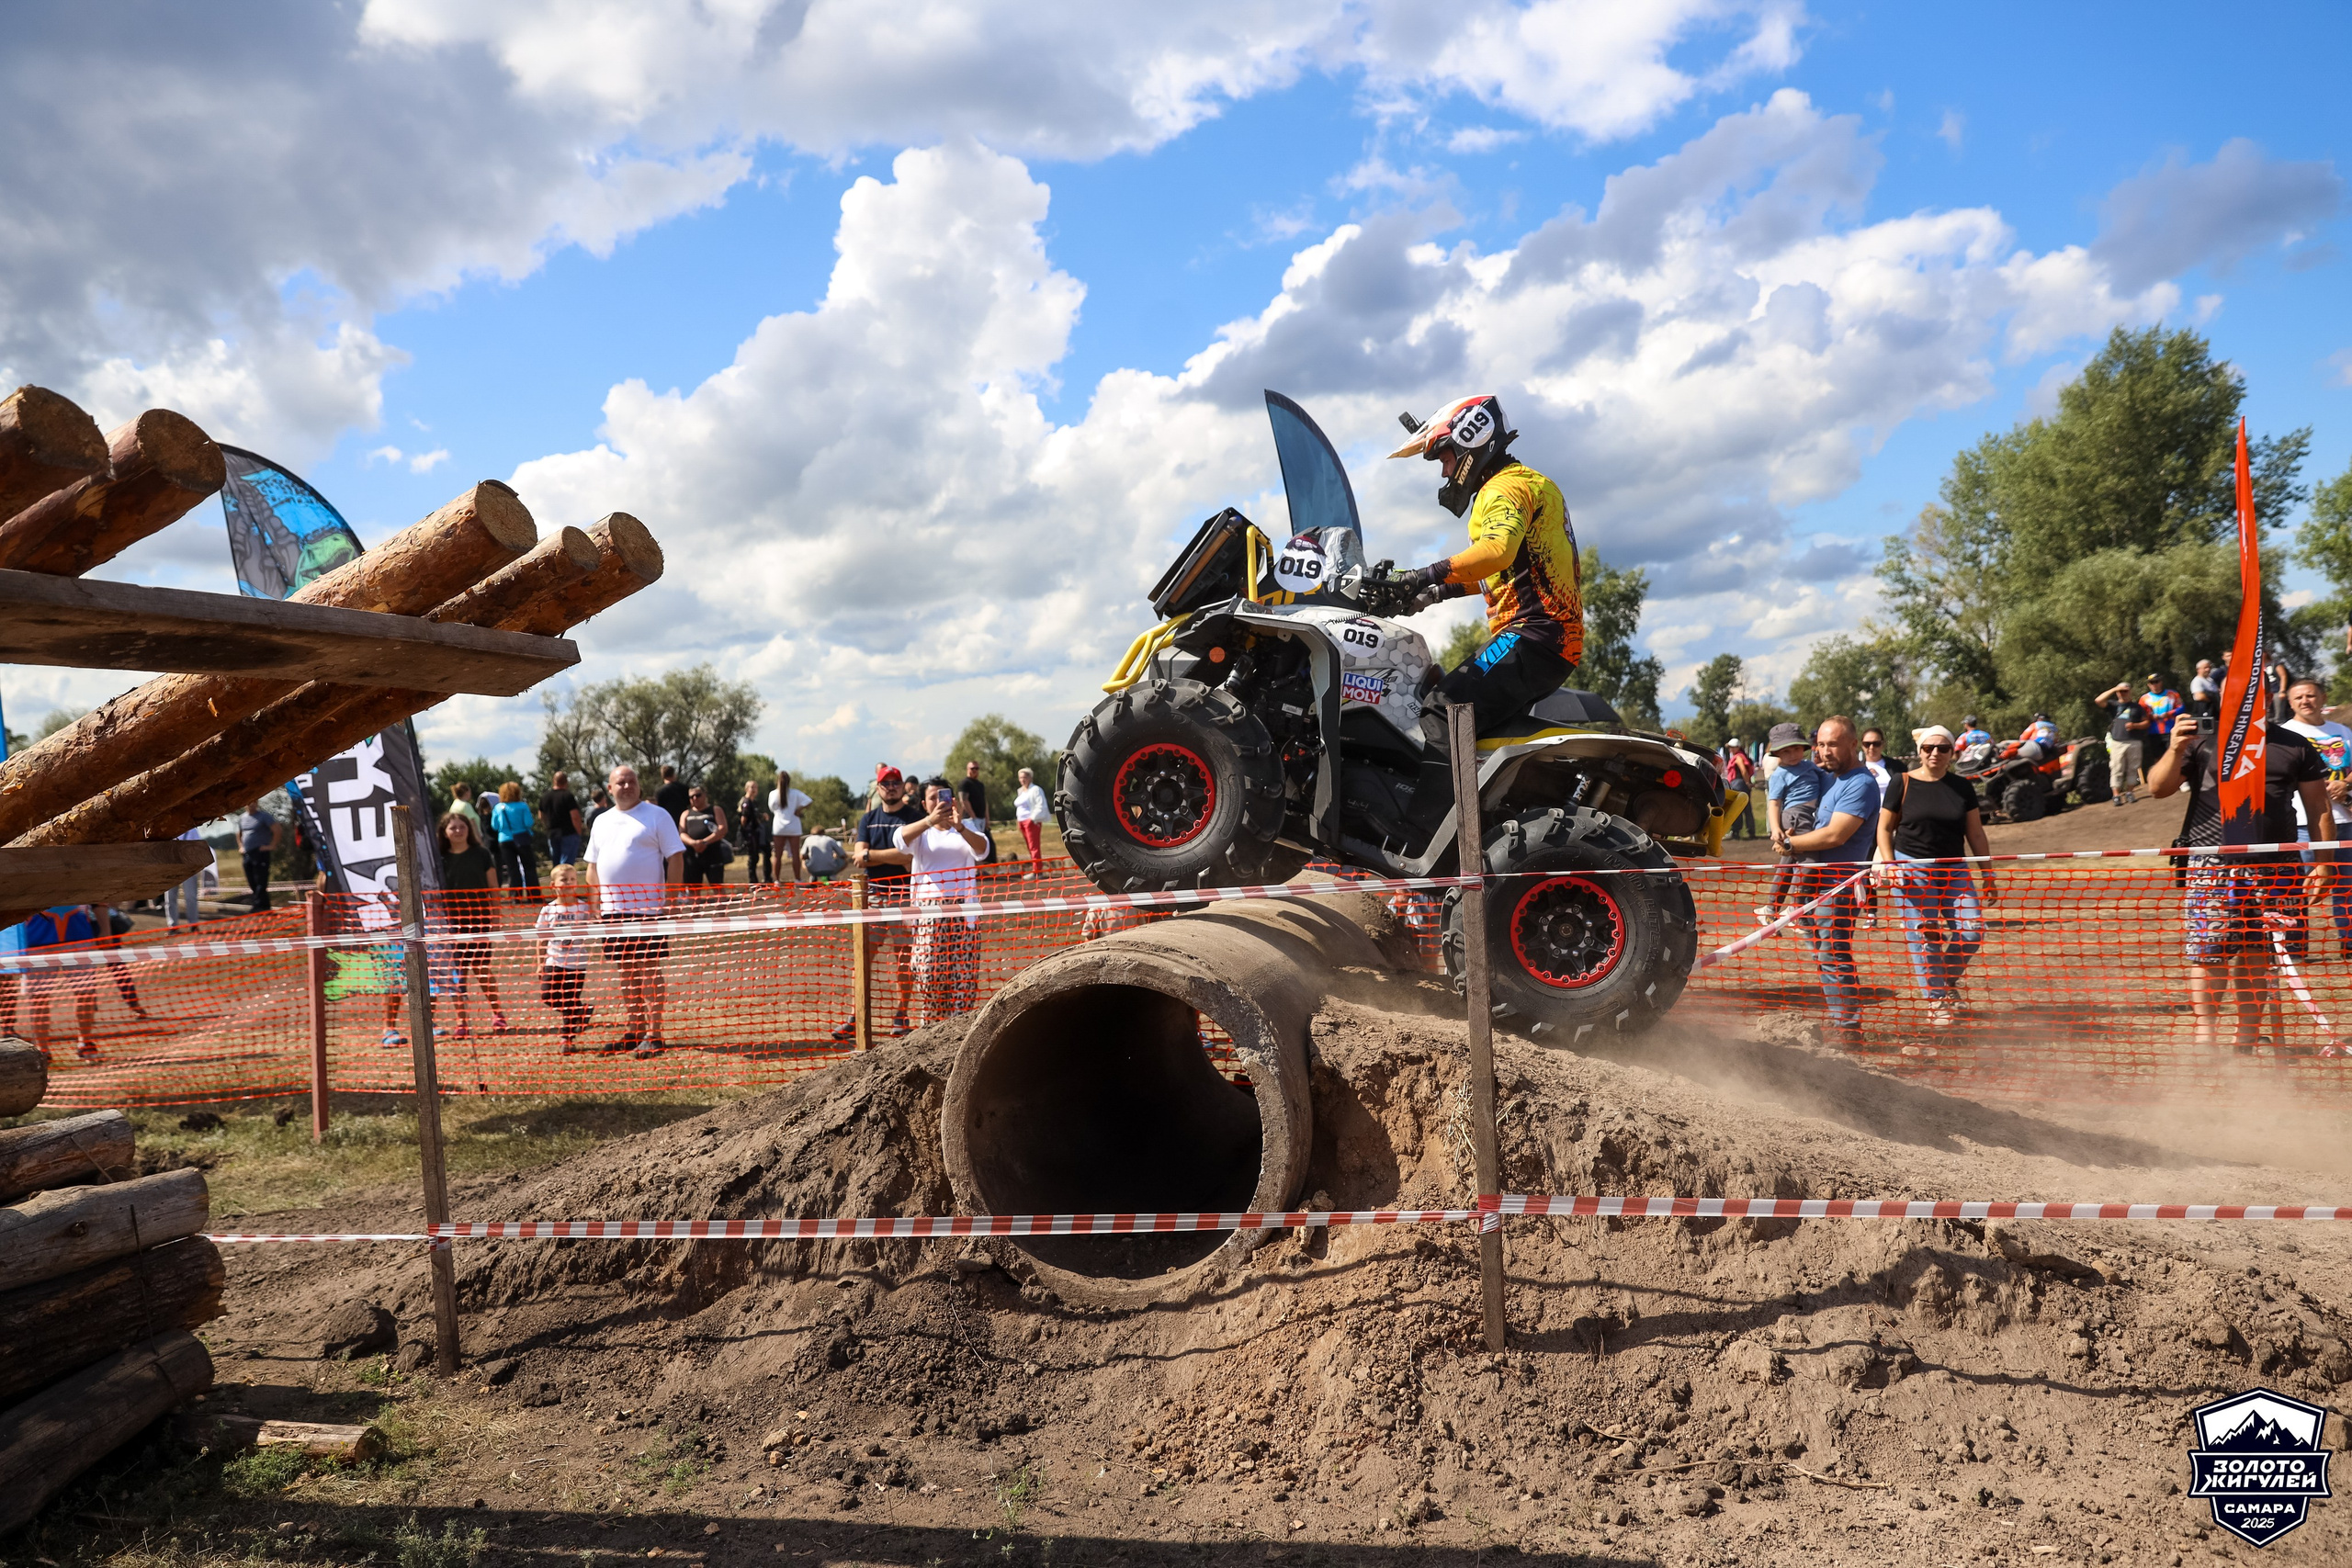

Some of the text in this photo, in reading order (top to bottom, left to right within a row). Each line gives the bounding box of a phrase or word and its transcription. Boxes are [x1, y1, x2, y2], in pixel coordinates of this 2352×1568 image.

[1459, 412, 1489, 443] 019
[1278, 556, 1322, 580] 019
[1343, 628, 1379, 649] 019
[1344, 673, 1382, 691] LIQUI
[1342, 686, 1380, 704] MOLY
